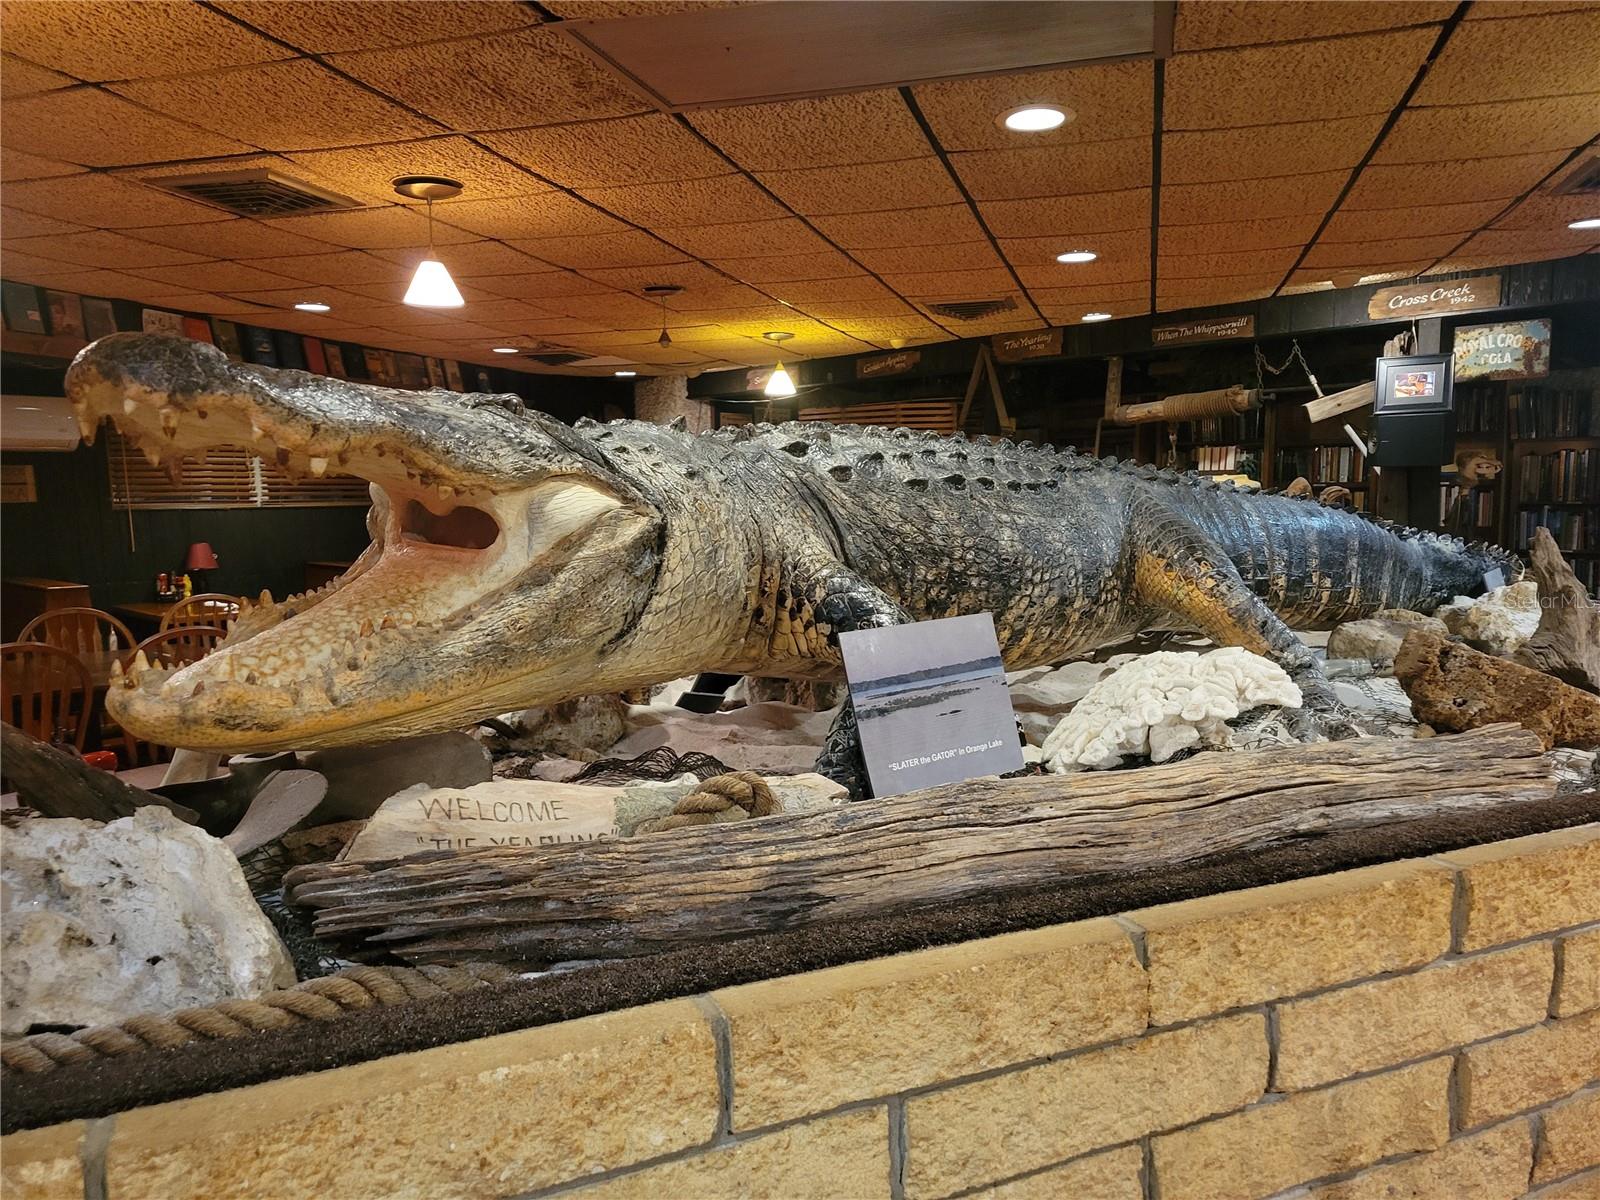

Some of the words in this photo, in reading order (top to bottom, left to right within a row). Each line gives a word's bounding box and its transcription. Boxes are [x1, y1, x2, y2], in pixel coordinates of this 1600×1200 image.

[1388, 295, 1429, 309] Cross
[1430, 283, 1471, 302] Creek
[1450, 294, 1476, 305] 1942
[1157, 329, 1179, 341] When
[1179, 327, 1193, 337] The
[1497, 333, 1537, 350] CRO
[919, 755, 932, 765] the
[965, 741, 989, 755] Orange
[988, 738, 1003, 749] Lake
[417, 798, 569, 823] WELCOME
